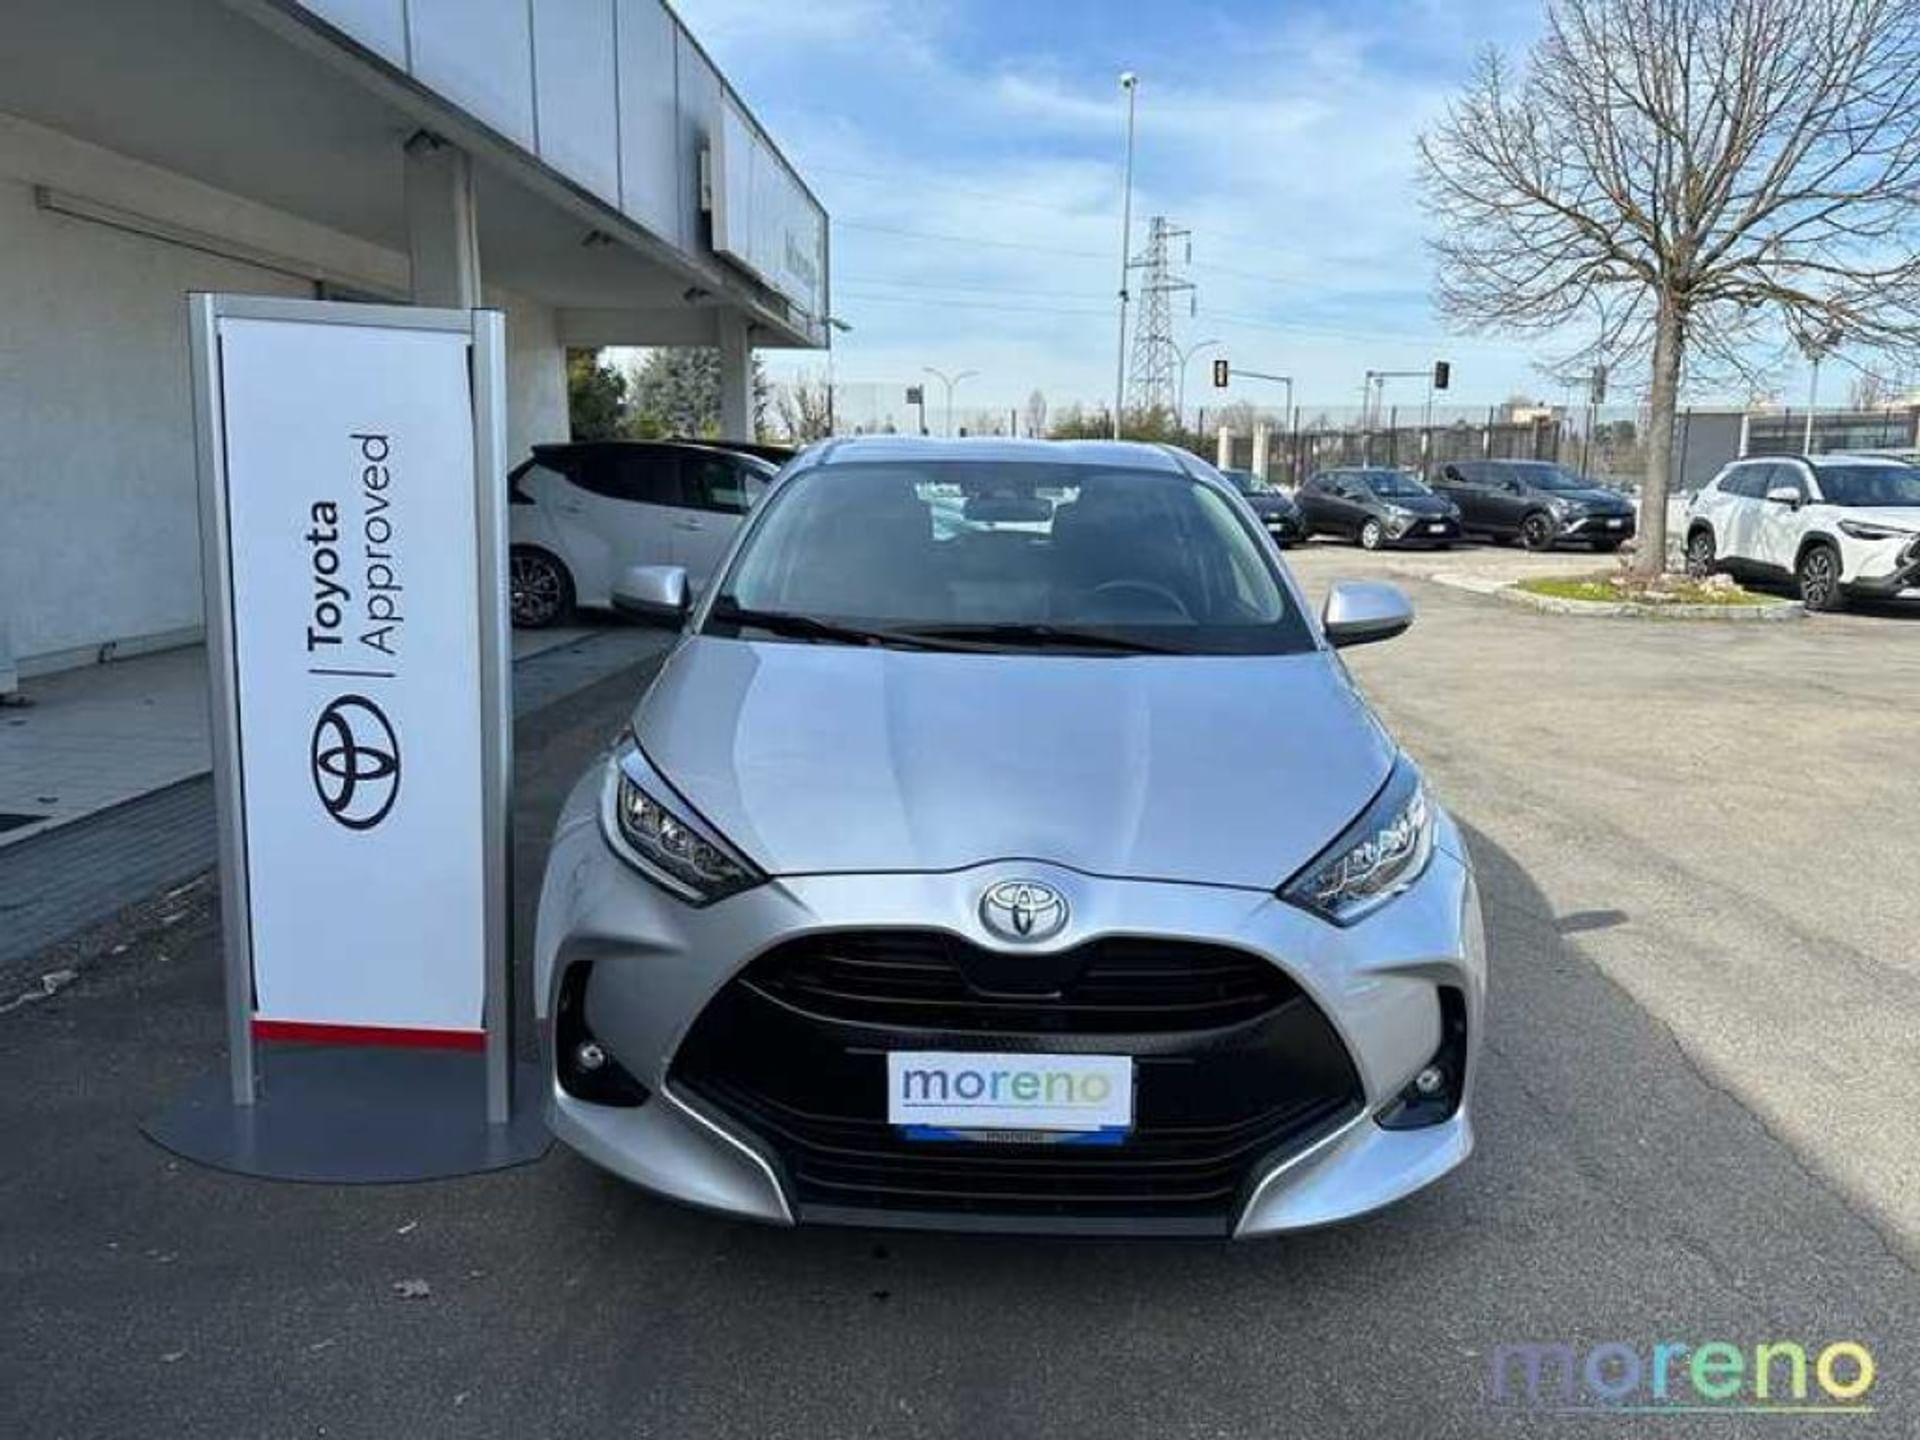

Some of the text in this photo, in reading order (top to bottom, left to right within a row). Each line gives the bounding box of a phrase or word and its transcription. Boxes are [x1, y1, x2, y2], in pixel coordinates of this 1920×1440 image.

[307, 500, 350, 652] Toyota
[349, 434, 404, 655] Approved
[903, 1069, 1112, 1102] moreno
